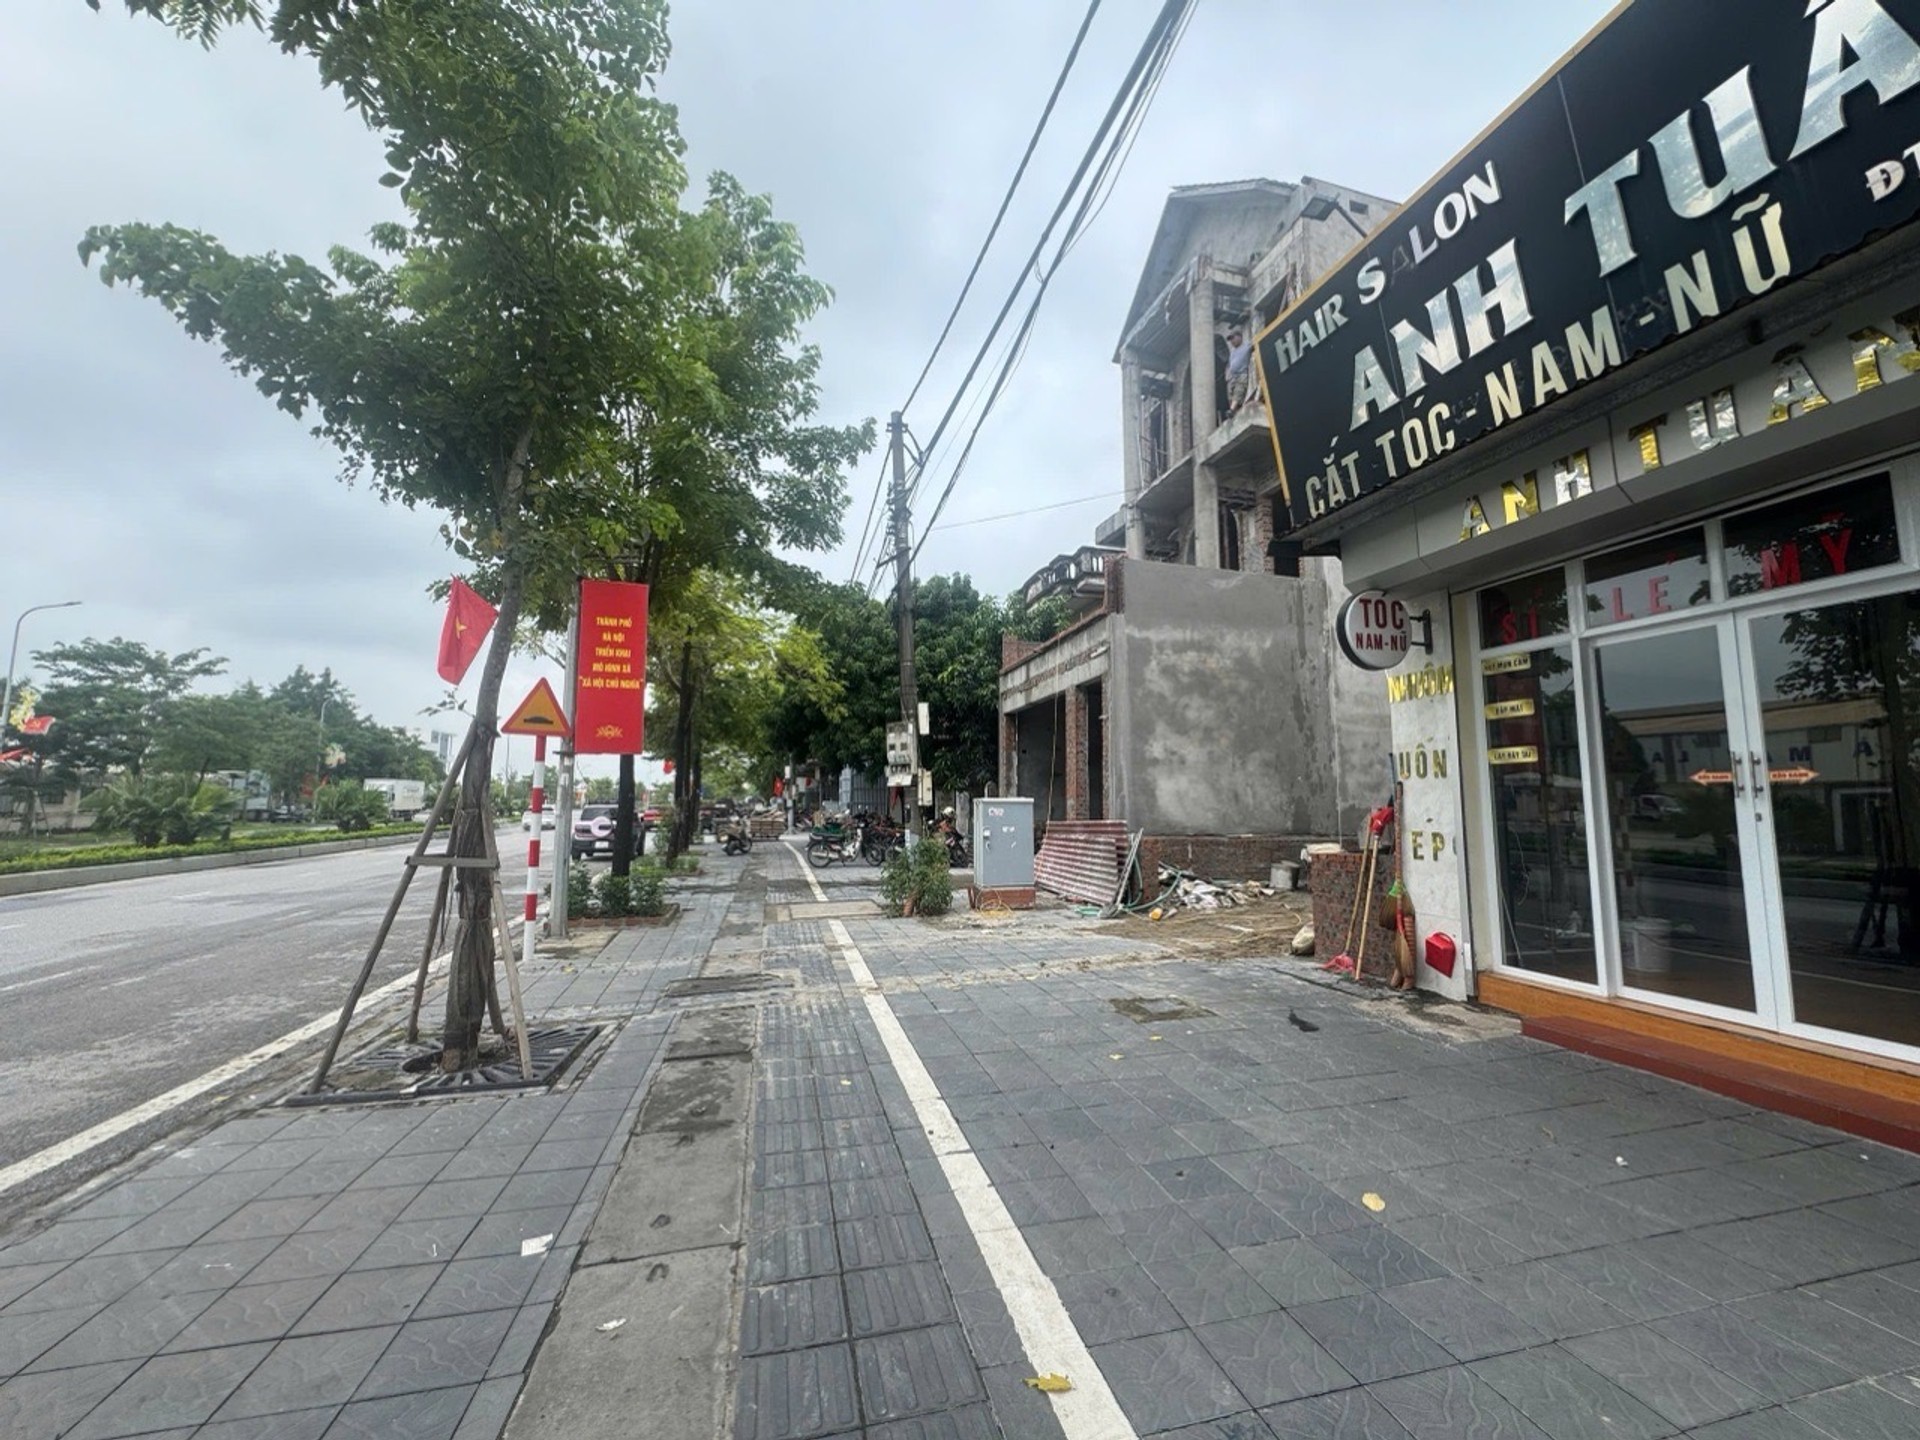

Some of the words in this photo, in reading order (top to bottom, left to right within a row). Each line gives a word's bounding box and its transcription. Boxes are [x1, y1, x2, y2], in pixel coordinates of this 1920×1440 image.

[1274, 293, 1349, 374] HAIR
[1349, 237, 1534, 432] ANH
[1304, 436, 1361, 520] CẮT
[1458, 448, 1594, 543] ANH
[1399, 736, 1448, 780] UỐN
